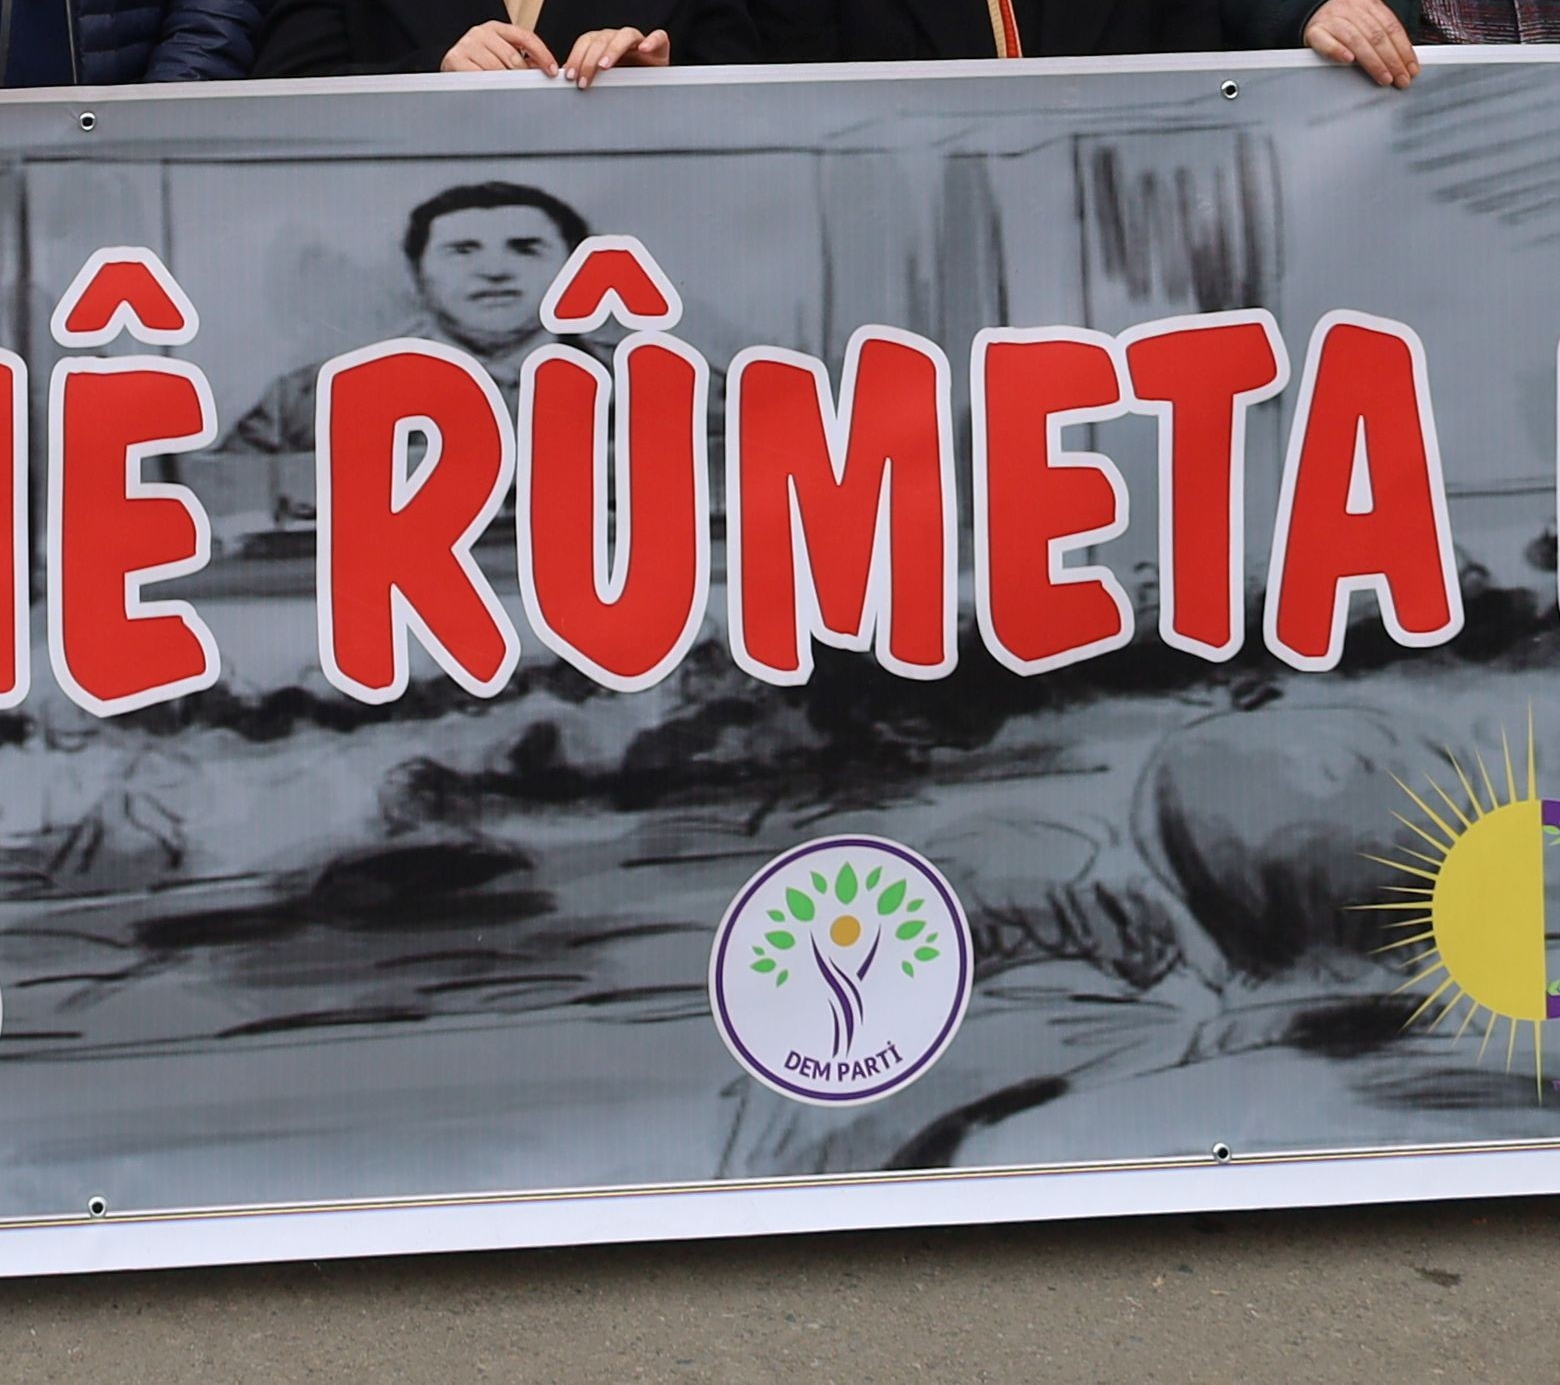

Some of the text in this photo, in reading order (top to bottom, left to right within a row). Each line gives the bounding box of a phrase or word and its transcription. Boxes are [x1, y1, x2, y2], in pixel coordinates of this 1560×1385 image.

[317, 236, 1463, 702] RÛMETA
[783, 1041, 903, 1082] DEM PARTİ
